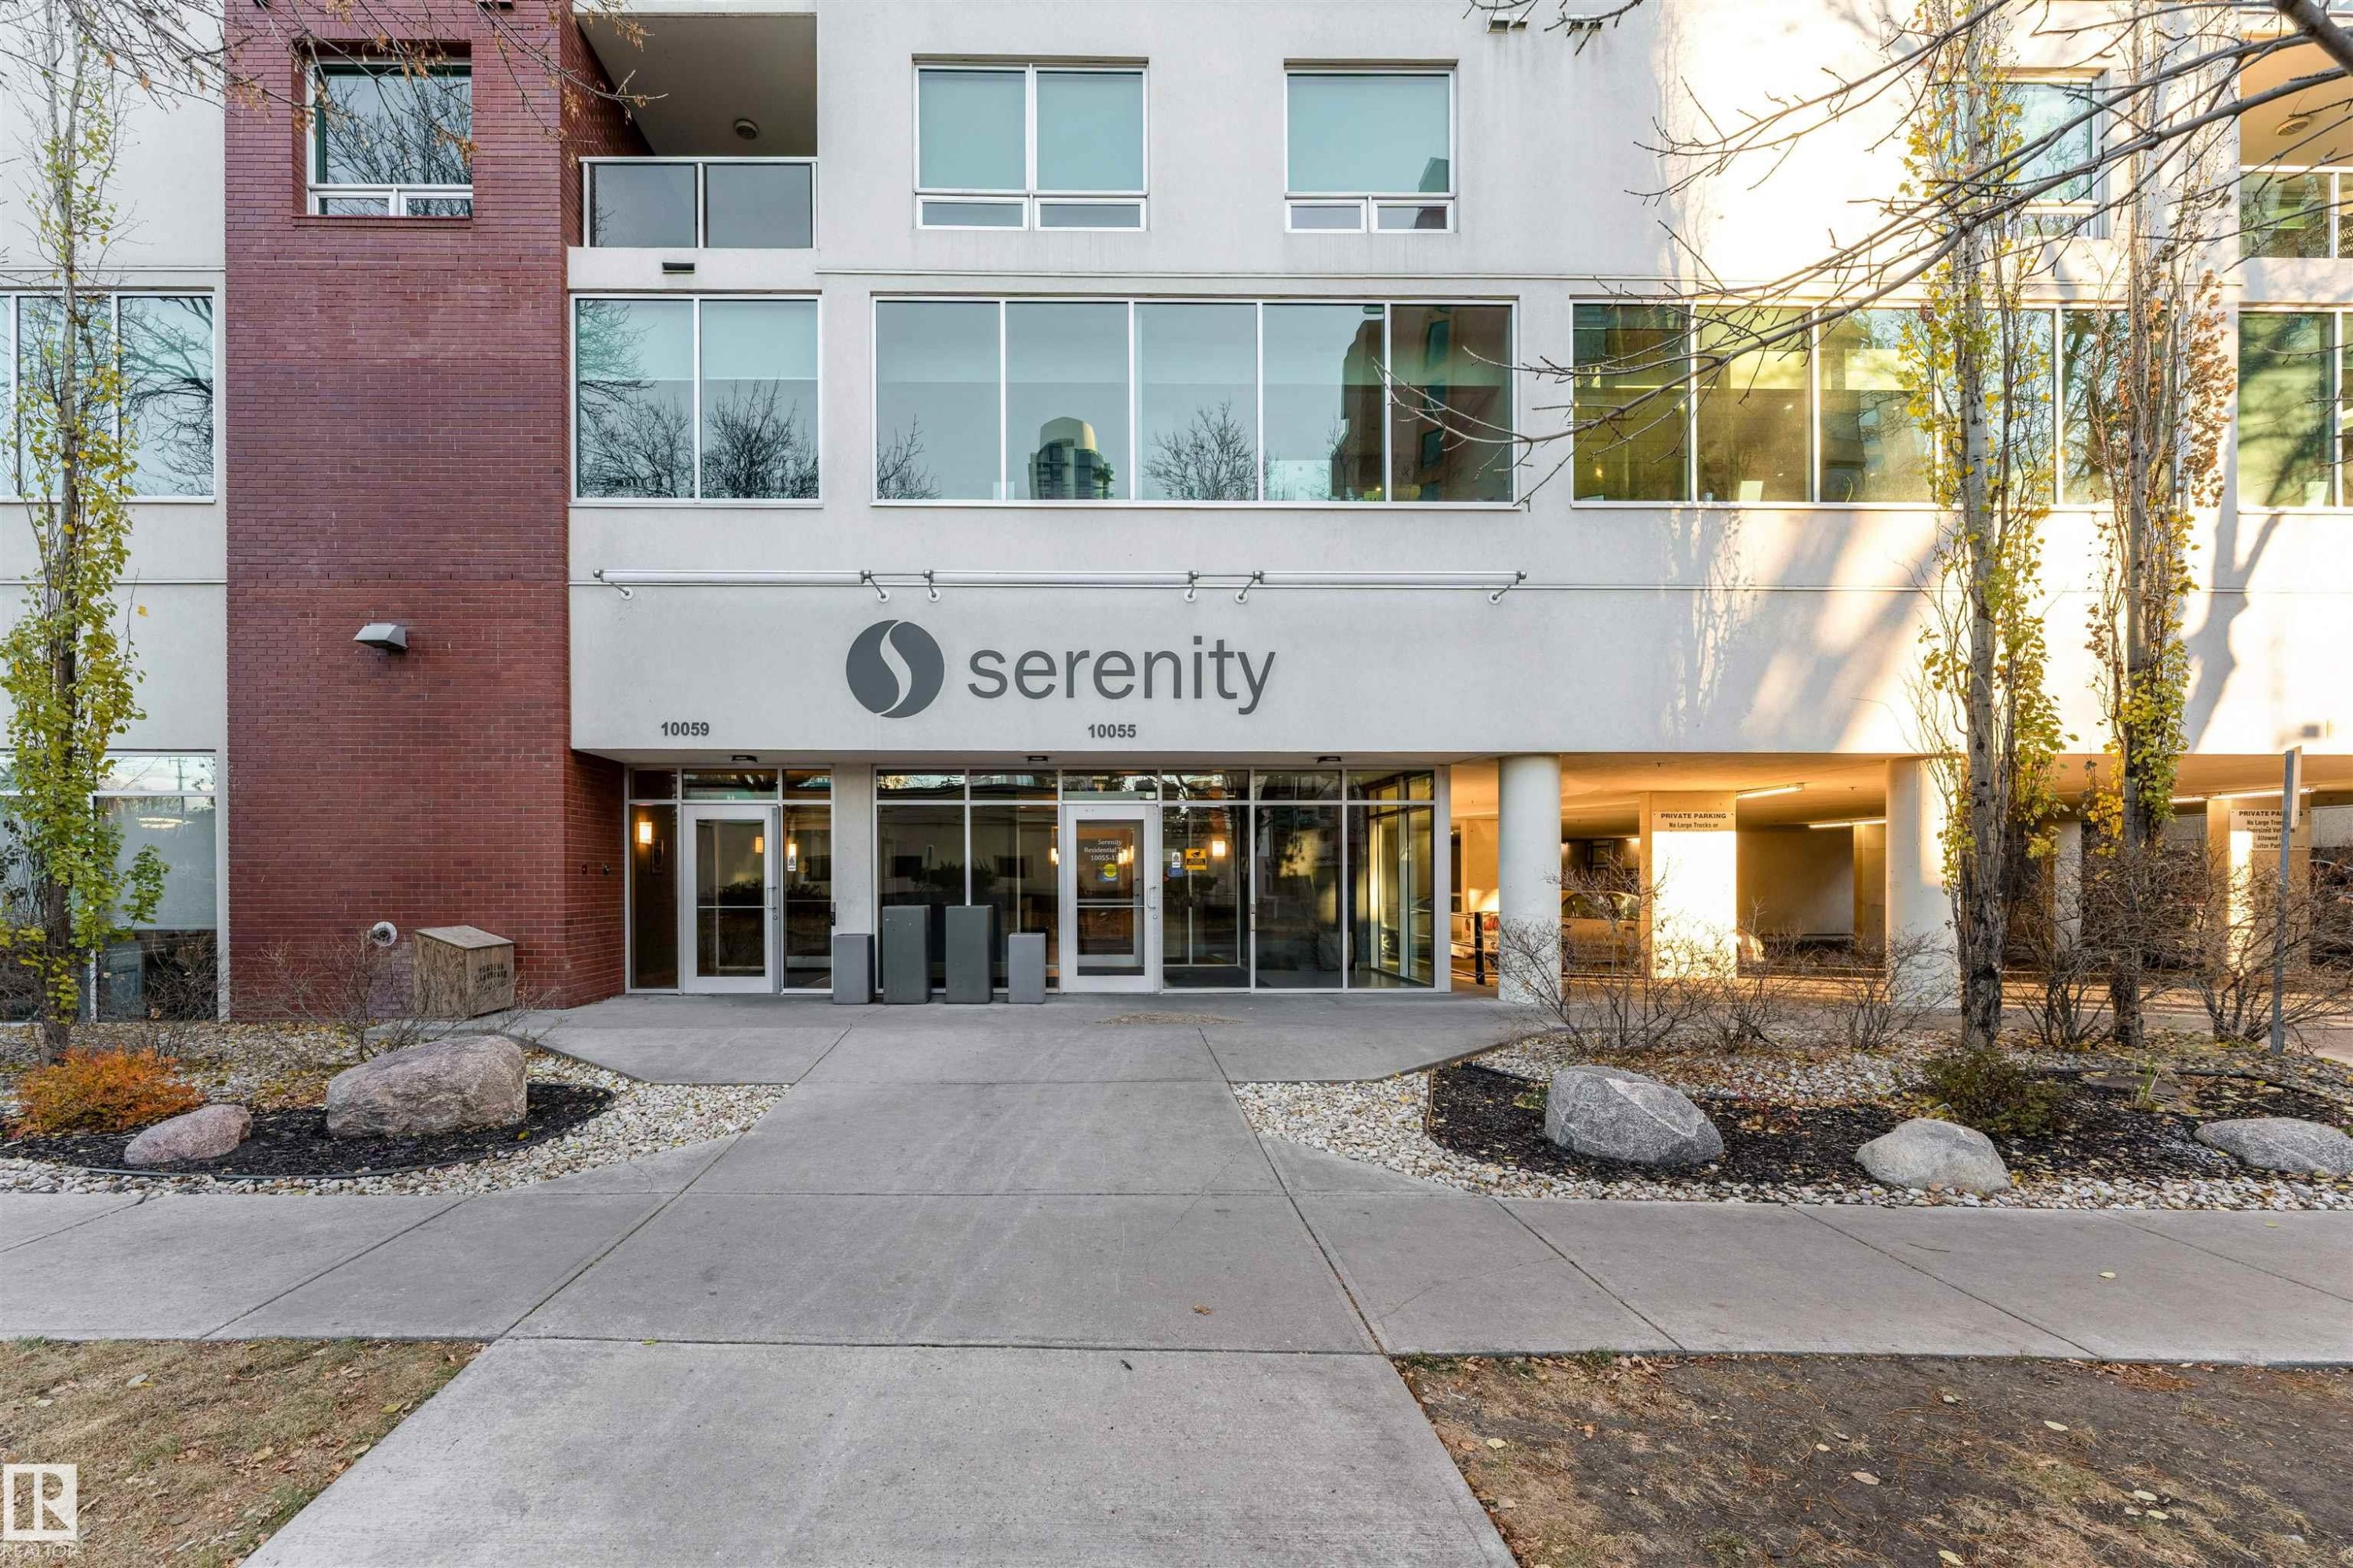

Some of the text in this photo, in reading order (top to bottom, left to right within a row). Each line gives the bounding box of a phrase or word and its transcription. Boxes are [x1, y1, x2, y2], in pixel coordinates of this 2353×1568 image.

[967, 635, 1276, 715] serenity
[660, 722, 710, 737] 10059
[1087, 723, 1136, 739] 10055
